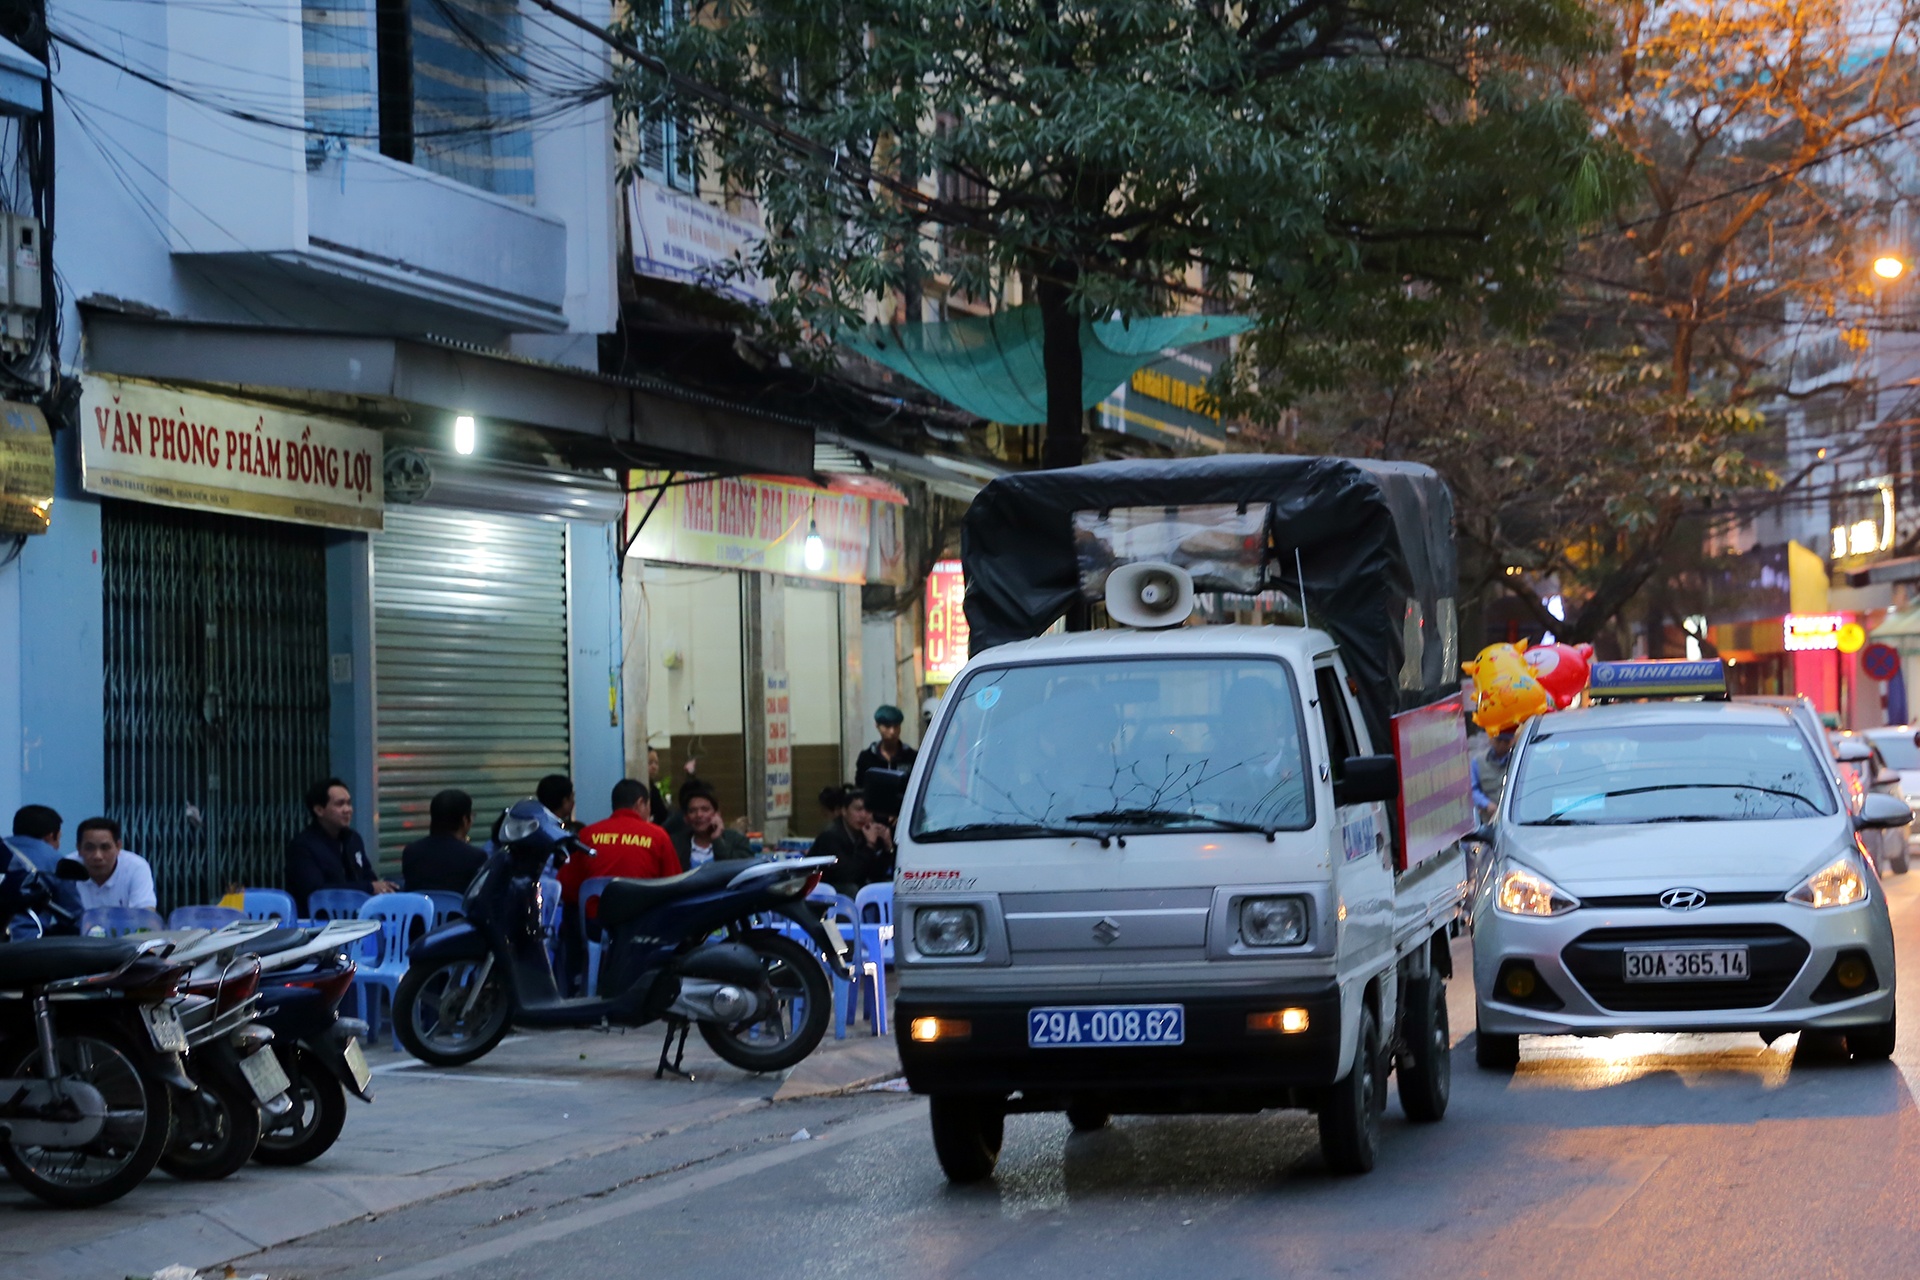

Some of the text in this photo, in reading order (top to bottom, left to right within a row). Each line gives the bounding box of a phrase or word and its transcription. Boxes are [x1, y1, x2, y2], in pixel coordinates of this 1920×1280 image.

[94, 394, 373, 503] VĂN PHÒNG PHẨM ĐỒNG LỢI
[591, 833, 652, 848] VIET NAM
[903, 870, 961, 880] SUPER
[1628, 952, 1744, 977] 30A-365.14
[1033, 1009, 1180, 1043] 29A-008.62
